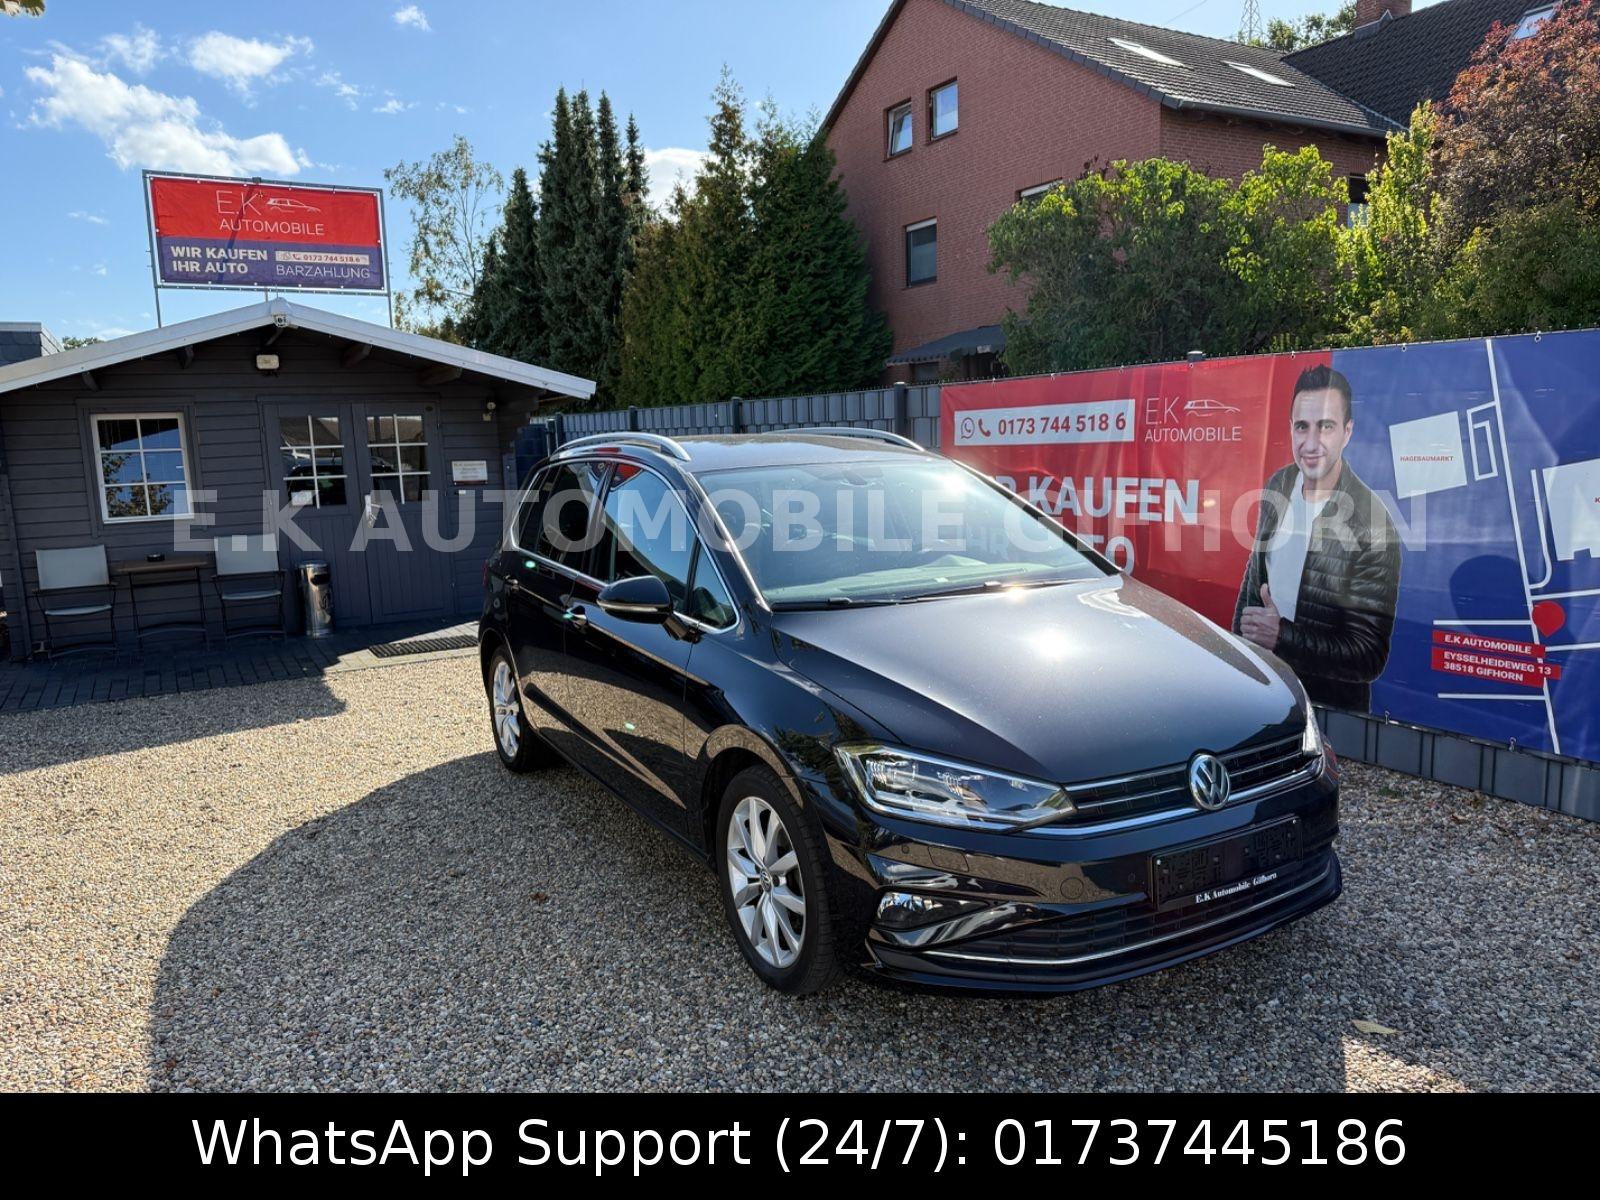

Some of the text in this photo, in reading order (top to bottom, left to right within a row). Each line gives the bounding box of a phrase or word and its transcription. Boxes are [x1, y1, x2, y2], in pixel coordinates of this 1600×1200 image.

[216, 190, 261, 216] E.K
[219, 219, 325, 236] AUTOMOBILE
[170, 246, 268, 261] WIR KAUFEN
[172, 260, 249, 274] IHR AUTO
[276, 264, 371, 279] BARZAHLUNG
[1144, 397, 1180, 425] E.K
[998, 412, 1127, 435] 0173 744 518 6
[1144, 426, 1242, 443] AUTOMOBILE
[1028, 475, 1199, 525] KAUFEN
[1444, 634, 1532, 654] E.K AUTOMOBILE
[1443, 652, 1551, 675] EYSSELHEIDEWEG 13
[1443, 662, 1524, 682] 38518 GIFHORN
[1195, 872, 1277, 904] E.K Automobile Gifhorn
